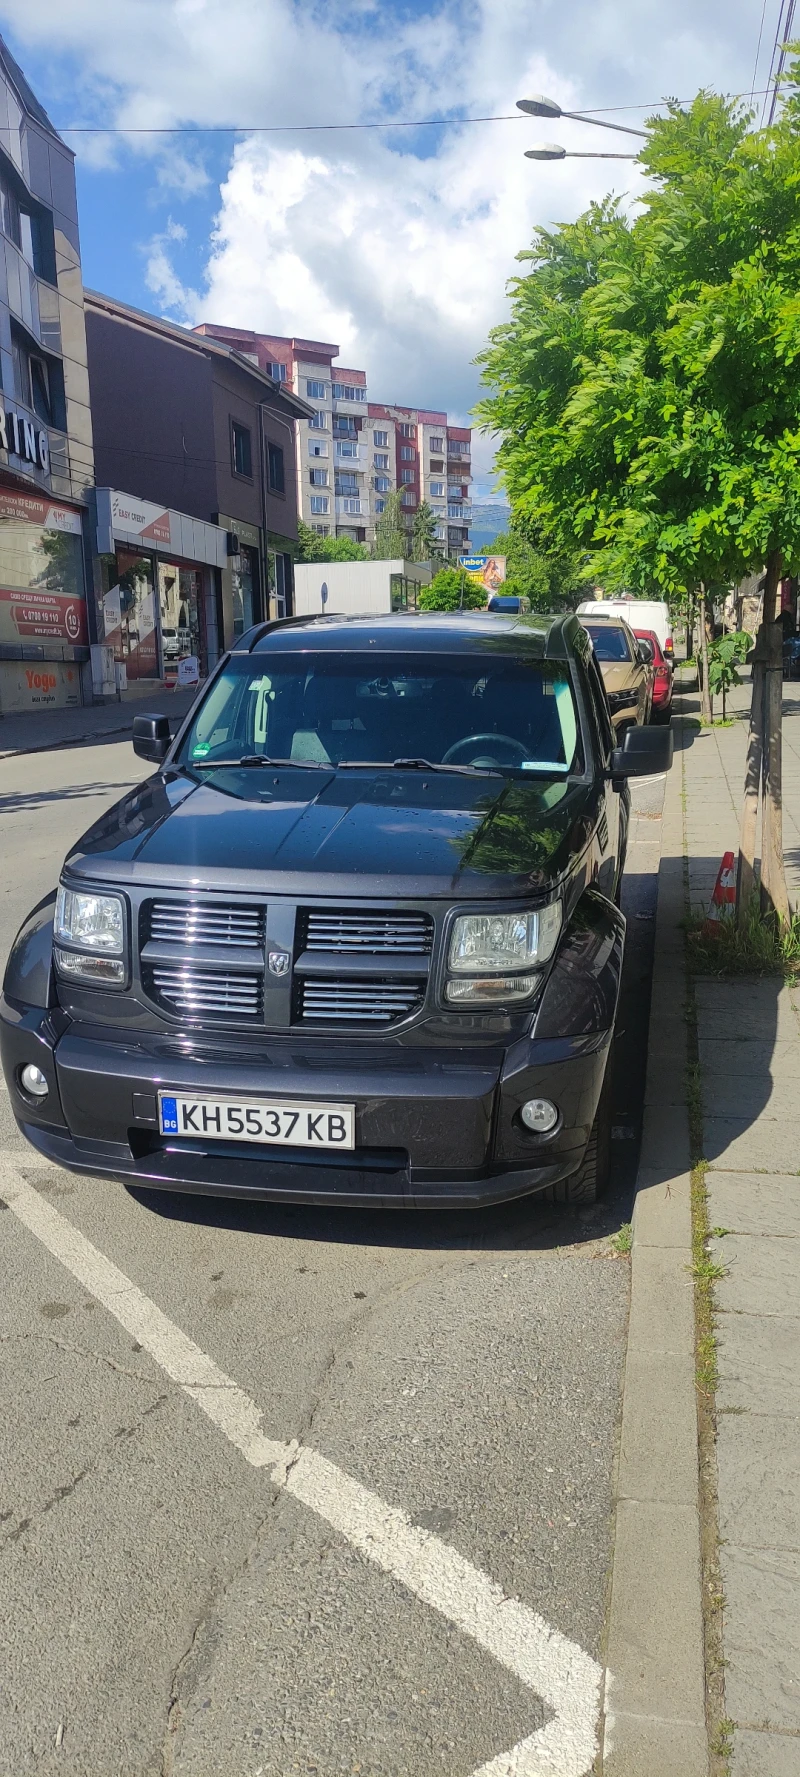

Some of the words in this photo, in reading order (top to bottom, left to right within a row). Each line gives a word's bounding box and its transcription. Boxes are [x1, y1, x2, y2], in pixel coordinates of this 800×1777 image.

[17, 498, 44, 512] КРЕДИТИ
[7, 506, 16, 516] 200
[57, 511, 66, 521] MY
[118, 509, 130, 519] EASY
[131, 512, 146, 524] CREDIT
[463, 557, 485, 566] inbet
[41, 612, 48, 621] 19
[68, 614, 77, 626] 10
[25, 669, 57, 693] Yoga
[164, 1119, 177, 1129] BG
